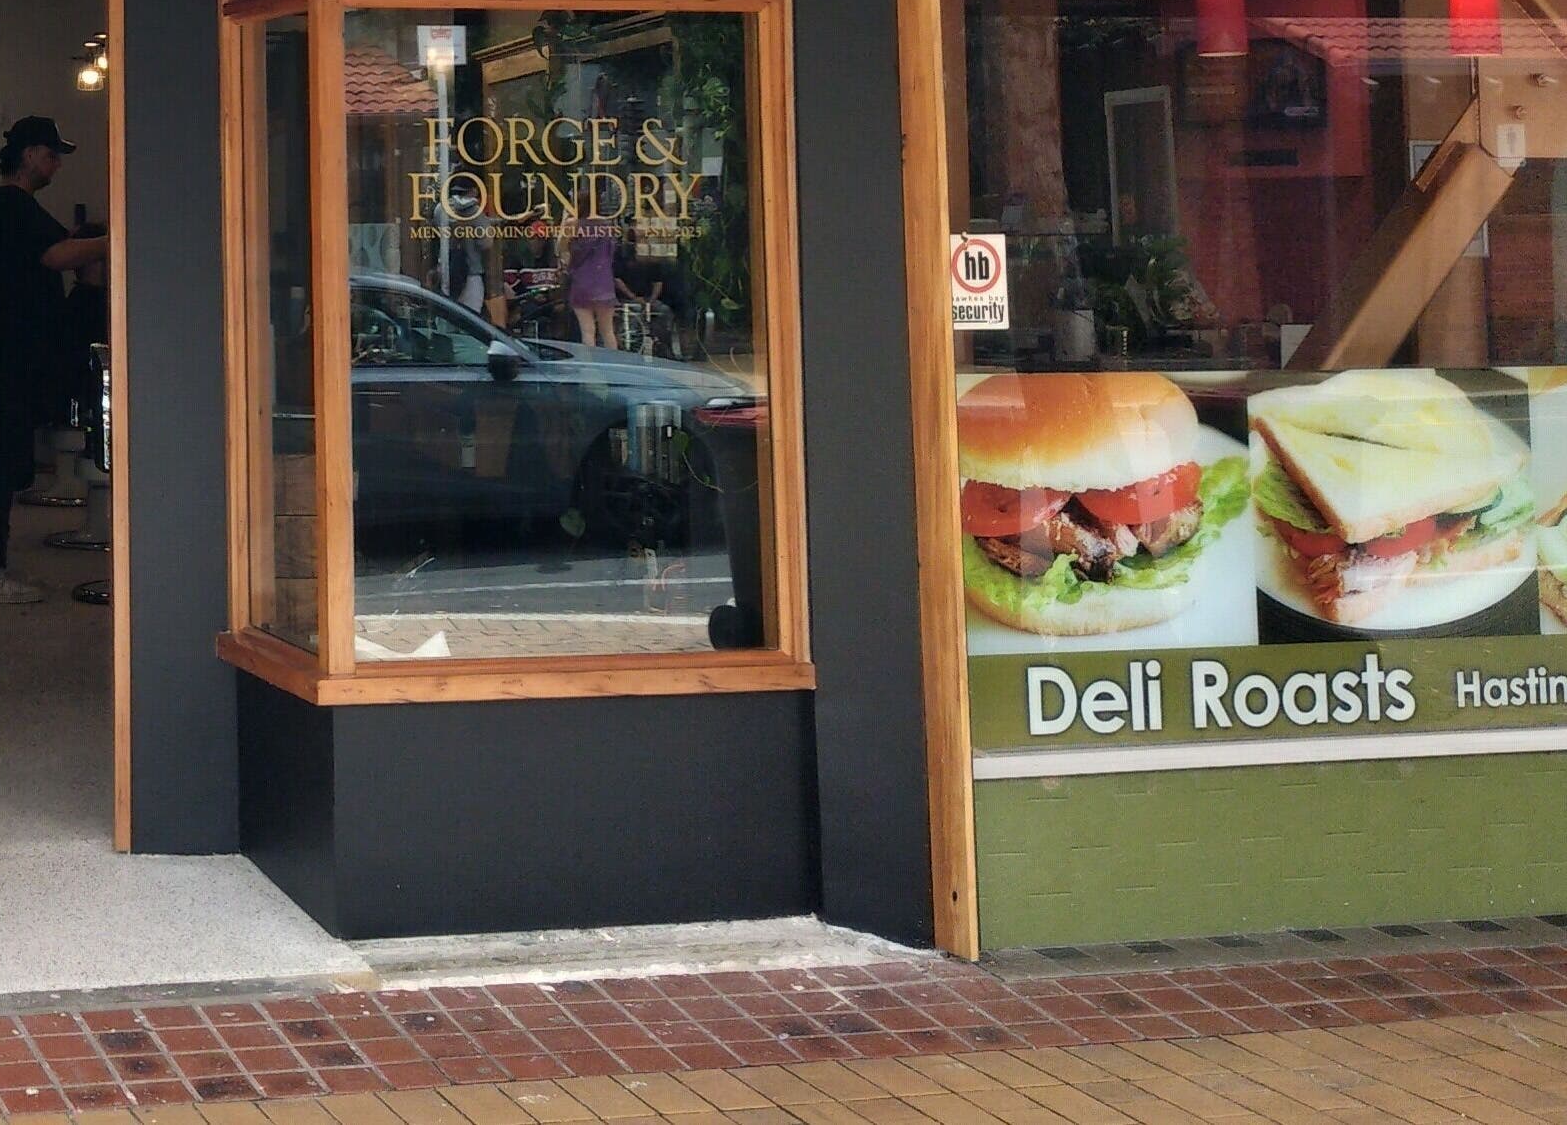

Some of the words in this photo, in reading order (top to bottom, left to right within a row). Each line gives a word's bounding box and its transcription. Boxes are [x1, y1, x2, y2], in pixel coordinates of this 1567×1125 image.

[422, 116, 623, 167] FORGE
[634, 117, 688, 167] &
[407, 171, 703, 223] FOUNDRY
[453, 225, 535, 239] GROOMING
[536, 225, 622, 239] SPECIALISTS
[964, 251, 990, 281] hb
[952, 301, 1005, 323] security
[1026, 658, 1164, 736] Deli
[1191, 652, 1417, 729] Roasts
[1455, 665, 1567, 709] Hastin
